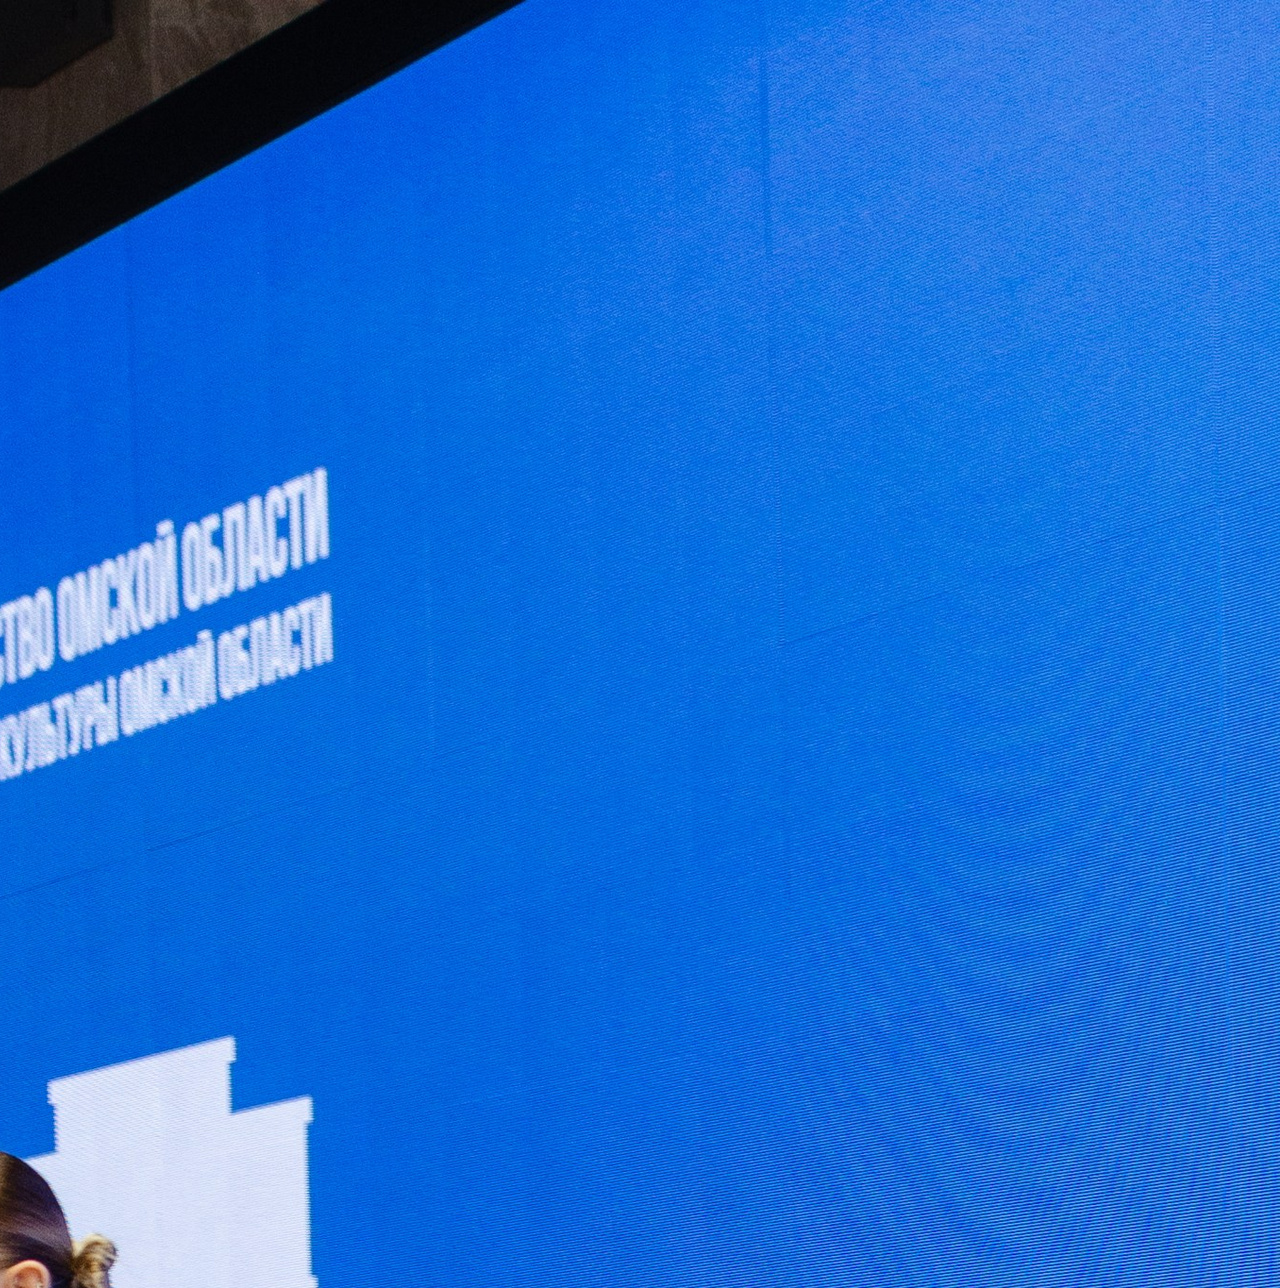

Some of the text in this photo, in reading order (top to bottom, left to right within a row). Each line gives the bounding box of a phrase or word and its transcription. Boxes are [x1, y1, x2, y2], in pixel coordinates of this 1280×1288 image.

[57, 518, 179, 661] ОМСКОЙ
[181, 466, 330, 611] ОБЛАСТИ
[119, 629, 217, 736] ОМСКОЙ
[218, 592, 333, 700] ОБЛАСТИ
